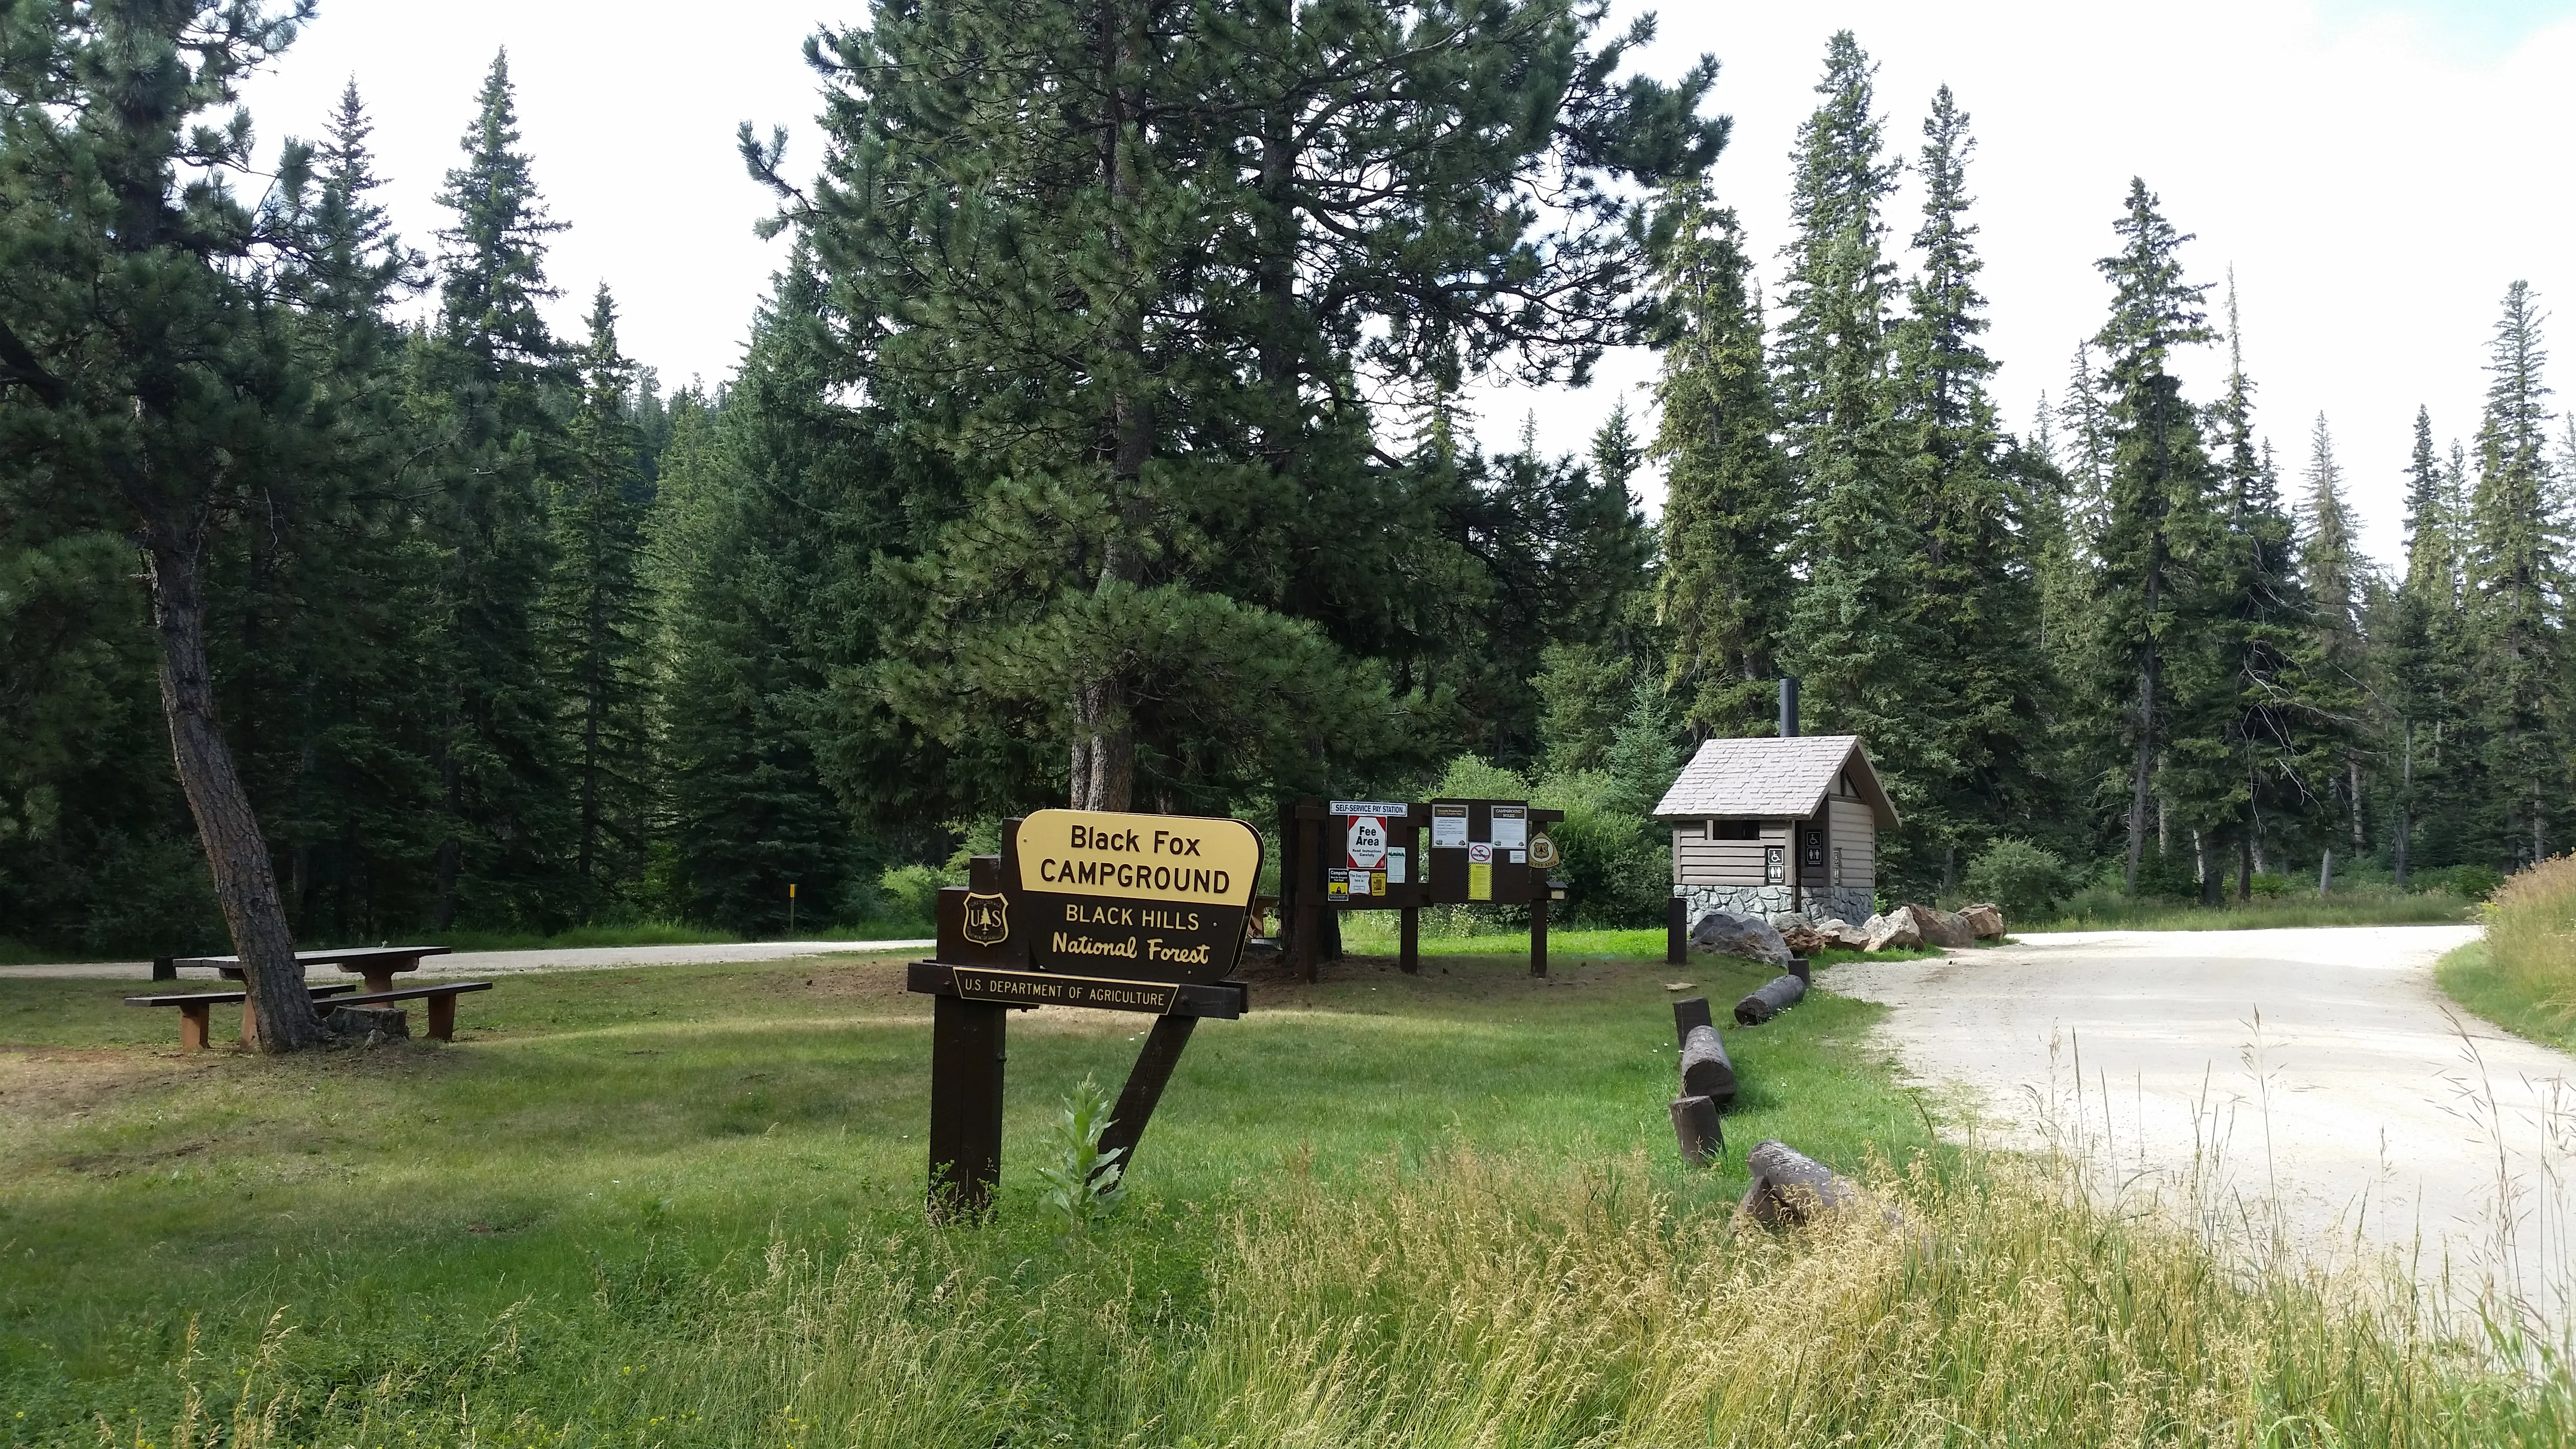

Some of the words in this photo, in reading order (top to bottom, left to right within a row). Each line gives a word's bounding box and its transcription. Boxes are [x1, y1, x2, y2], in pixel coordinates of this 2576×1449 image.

[1071, 825, 1140, 852] Black
[1154, 830, 1201, 856] Fox
[1356, 836, 1379, 846] Area
[1359, 826, 1376, 836] Fee
[1041, 858, 1230, 894] CAMPGROUND
[1066, 904, 1133, 926] BLACK
[1142, 910, 1199, 930] HILLS
[1052, 932, 1137, 958] National
[1147, 938, 1210, 964] Forest
[965, 979, 983, 991] U.S.
[990, 981, 1062, 998] DEPARTMENT
[1069, 986, 1083, 999] OF
[1089, 989, 1164, 1006] AGRICULTURE
